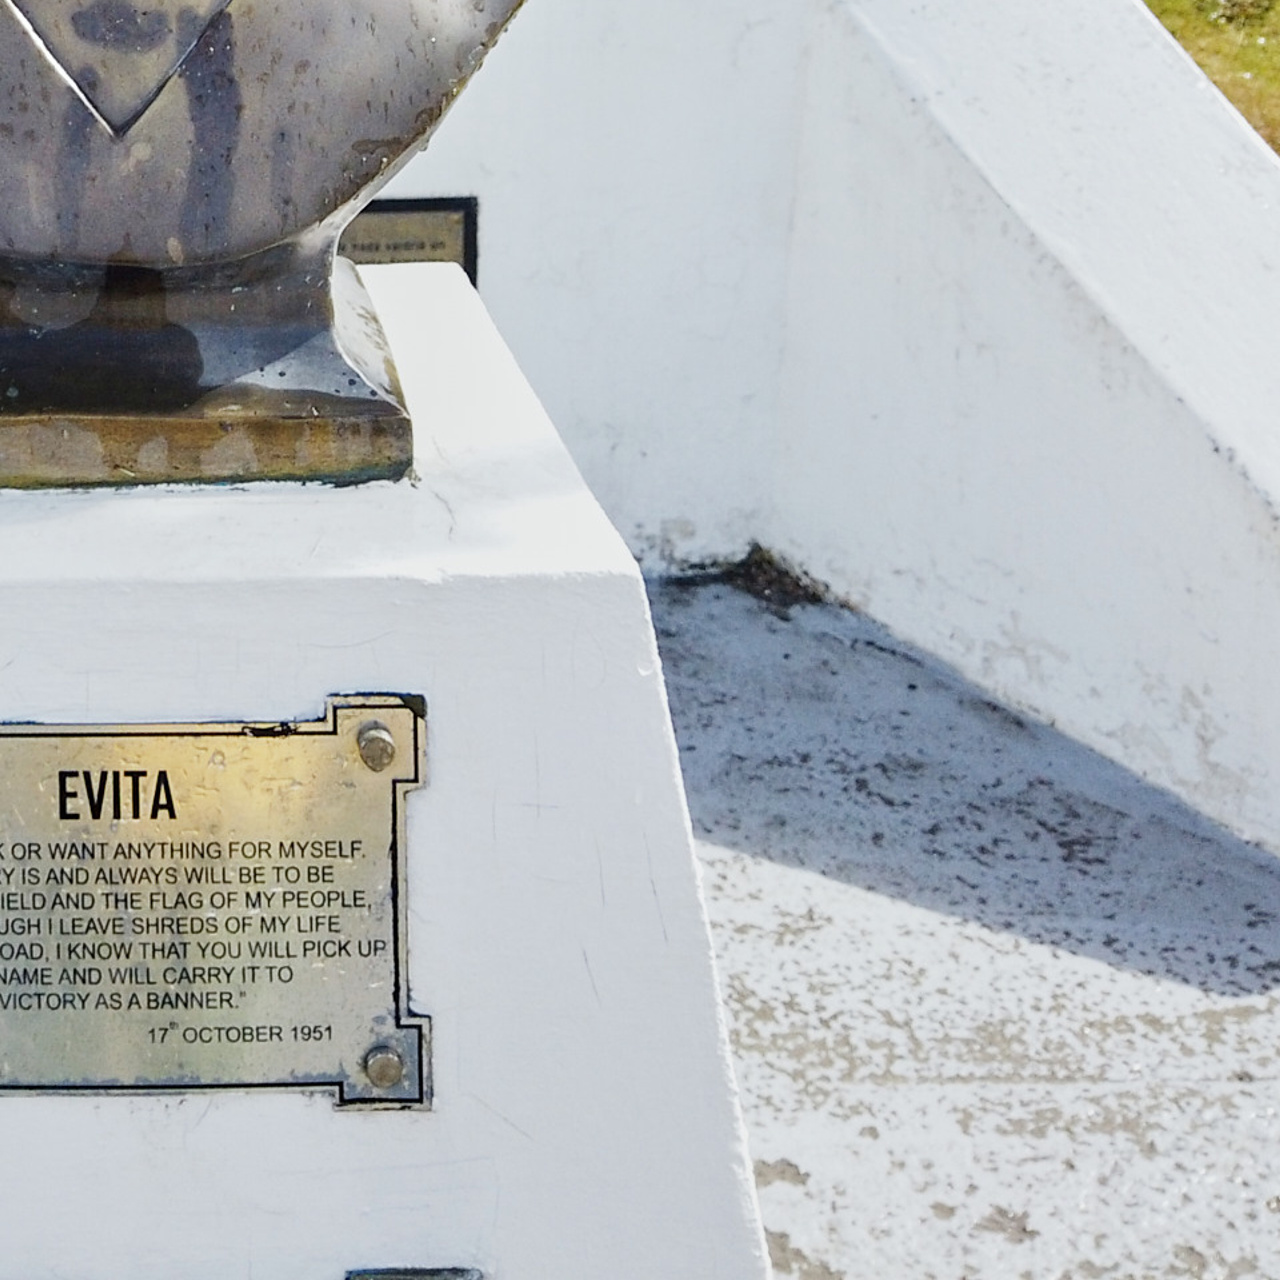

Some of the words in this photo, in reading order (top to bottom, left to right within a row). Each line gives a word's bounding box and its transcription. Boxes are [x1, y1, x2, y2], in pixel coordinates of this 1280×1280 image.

[58, 769, 178, 820] EVITA
[10, 842, 42, 862] OR
[48, 842, 110, 862] WANT
[113, 841, 222, 860] ANYTHING
[228, 840, 272, 860] FOR
[278, 839, 366, 859] MYSELF.
[21, 865, 41, 886] IS
[45, 865, 90, 886] AND
[95, 865, 178, 886] ALWAYS
[183, 865, 233, 886] WILL
[238, 865, 266, 886] BE
[271, 865, 301, 886] TO
[306, 865, 335, 886] BE
[50, 890, 96, 912] AND
[100, 890, 143, 912] THE
[149, 890, 204, 912] FLAG
[209, 890, 239, 912] OF
[244, 890, 276, 912] MY
[281, 890, 372, 910] PEOPLE,
[48, 916, 53, 936] I
[59, 916, 125, 936] LEAVE
[131, 916, 219, 936] SHREDS
[224, 916, 253, 936] OF
[259, 916, 292, 936] MY
[296, 916, 342, 936] LIFE
[56, 941, 61, 961] I
[67, 941, 133, 961] KNOW
[138, 941, 192, 961] THAT
[196, 940, 242, 960] YOU
[247, 940, 298, 960] WILL
[302, 939, 352, 959] PICK
[357, 939, 387, 958] UP
[58, 966, 103, 986] AND
[107, 966, 158, 986] WILL
[162, 966, 236, 986] CARRY
[241, 966, 261, 986] IT
[264, 966, 294, 986] TO
[94, 990, 123, 1011] AS
[126, 990, 142, 1011] A
[182, 1025, 284, 1044] OCTOBER
[290, 1024, 332, 1043] 1951
